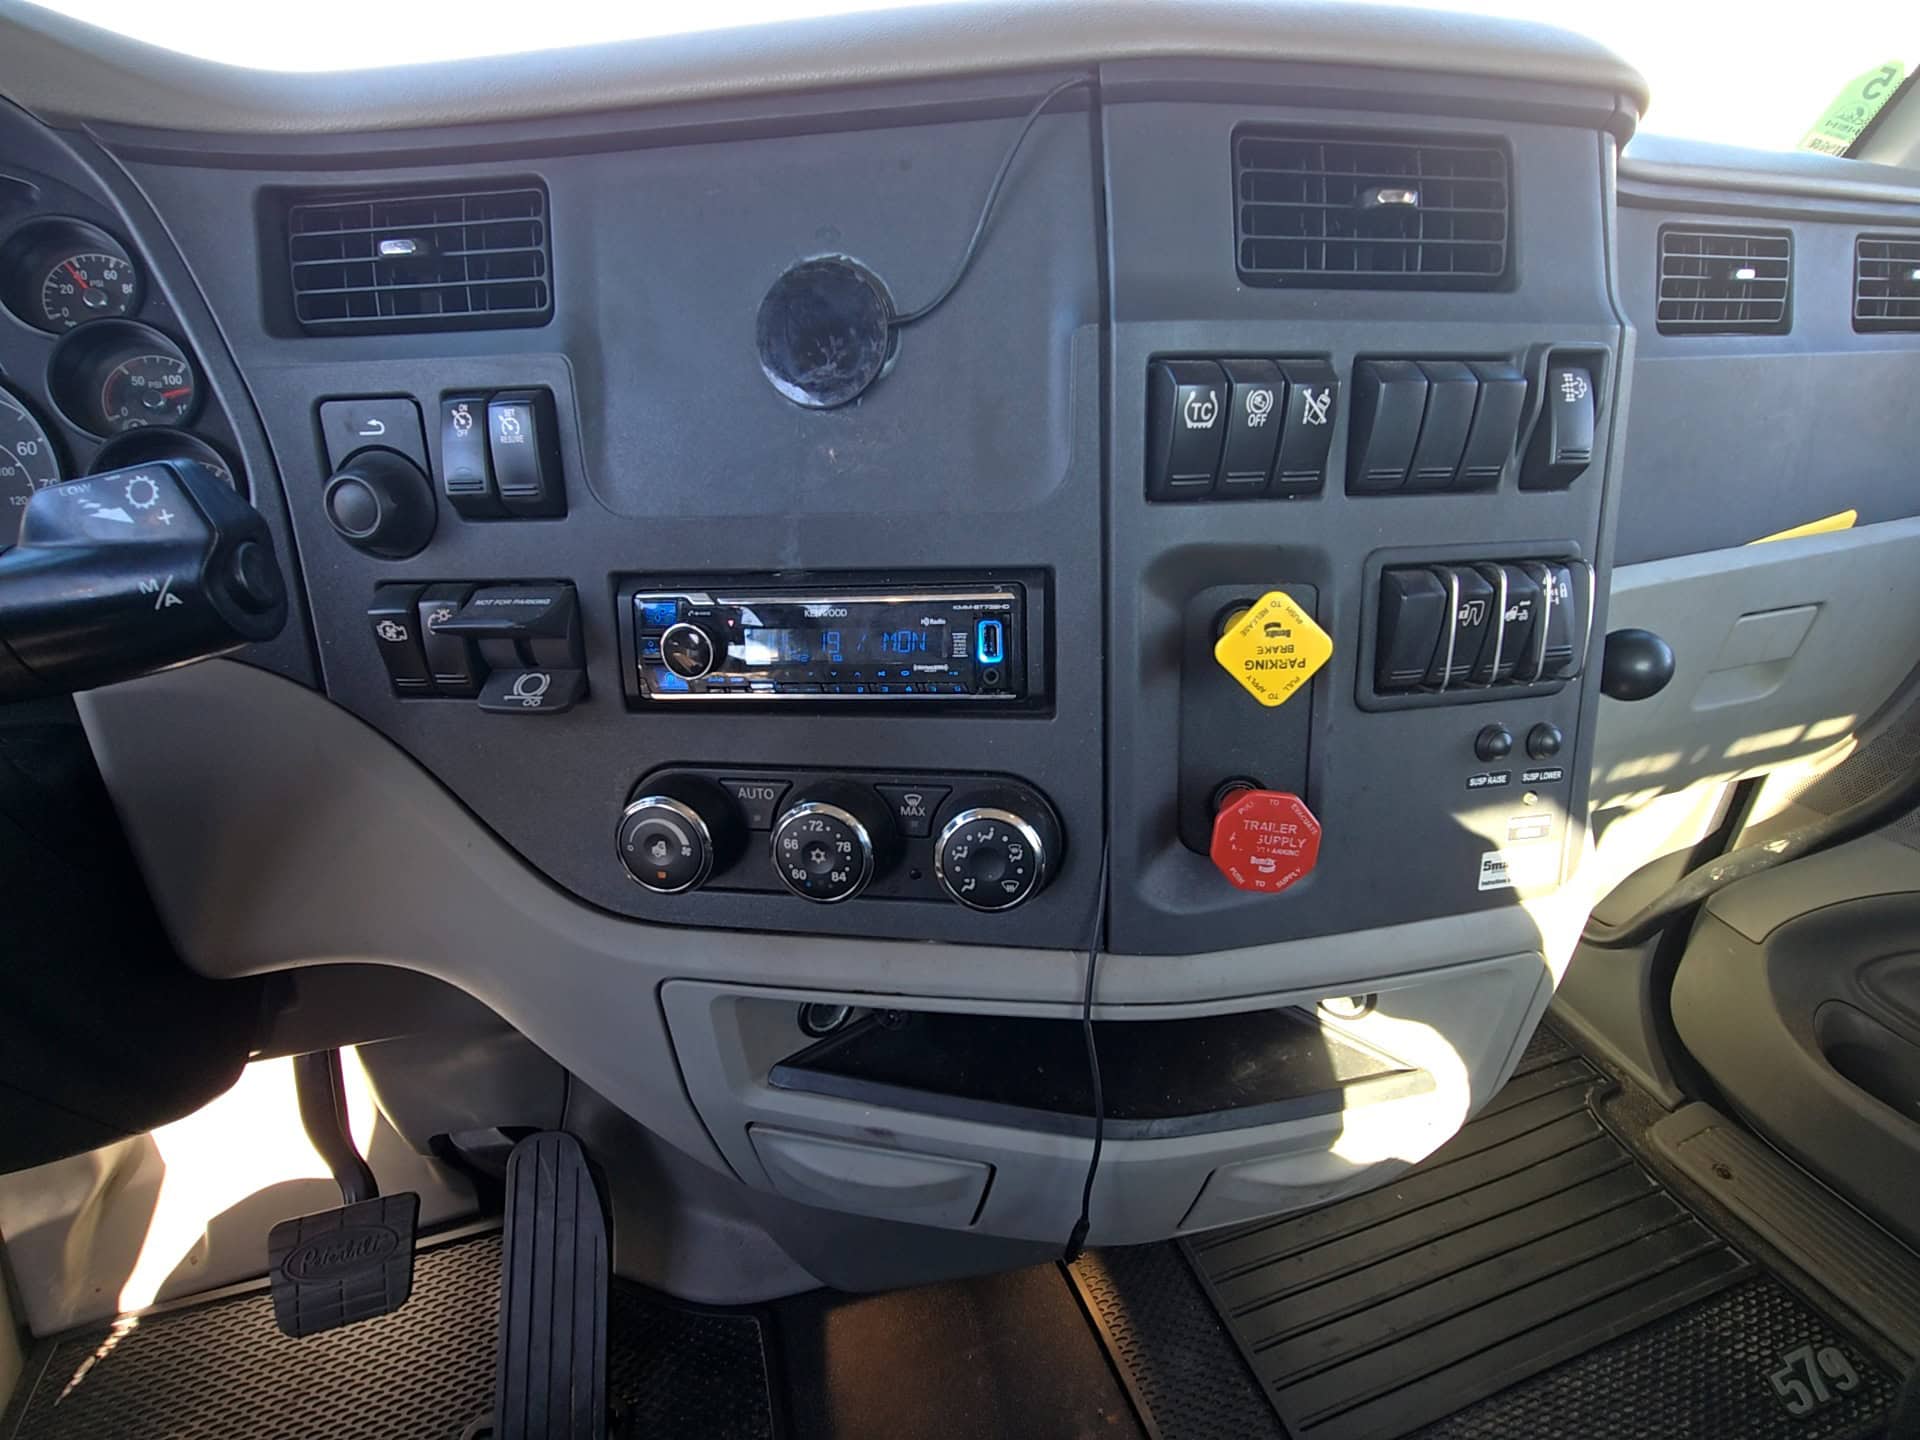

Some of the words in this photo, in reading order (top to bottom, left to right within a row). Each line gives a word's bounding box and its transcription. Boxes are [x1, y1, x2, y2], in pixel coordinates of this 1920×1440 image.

[103, 270, 118, 281] 60
[59, 284, 74, 294] 20
[61, 307, 69, 318] 0
[131, 376, 145, 386] 50
[162, 375, 183, 385] 100
[121, 406, 129, 417] 0
[1191, 402, 1213, 421] TC
[1247, 413, 1268, 428] OFF
[16, 441, 37, 456] 60
[59, 483, 92, 497] LOW
[1270, 600, 1282, 608] TO
[804, 607, 848, 618] KENWOOD
[1240, 607, 1269, 638] RELEASE
[881, 630, 927, 654] MON
[1256, 644, 1295, 655] BRAKE
[1244, 657, 1306, 671] PARKING
[1246, 674, 1266, 693] APPLY
[1268, 692, 1279, 700] TO
[1539, 769, 1562, 781] LOWER
[738, 787, 775, 800] AUTO
[900, 805, 926, 817] MAX
[808, 820, 824, 832] 72
[1243, 819, 1298, 835] TRAILER
[783, 838, 799, 850] 66
[836, 841, 852, 853] 78
[791, 868, 808, 880] 60
[831, 871, 847, 882] 84
[1255, 879, 1266, 887] TO
[1770, 1344, 1860, 1415] 579
